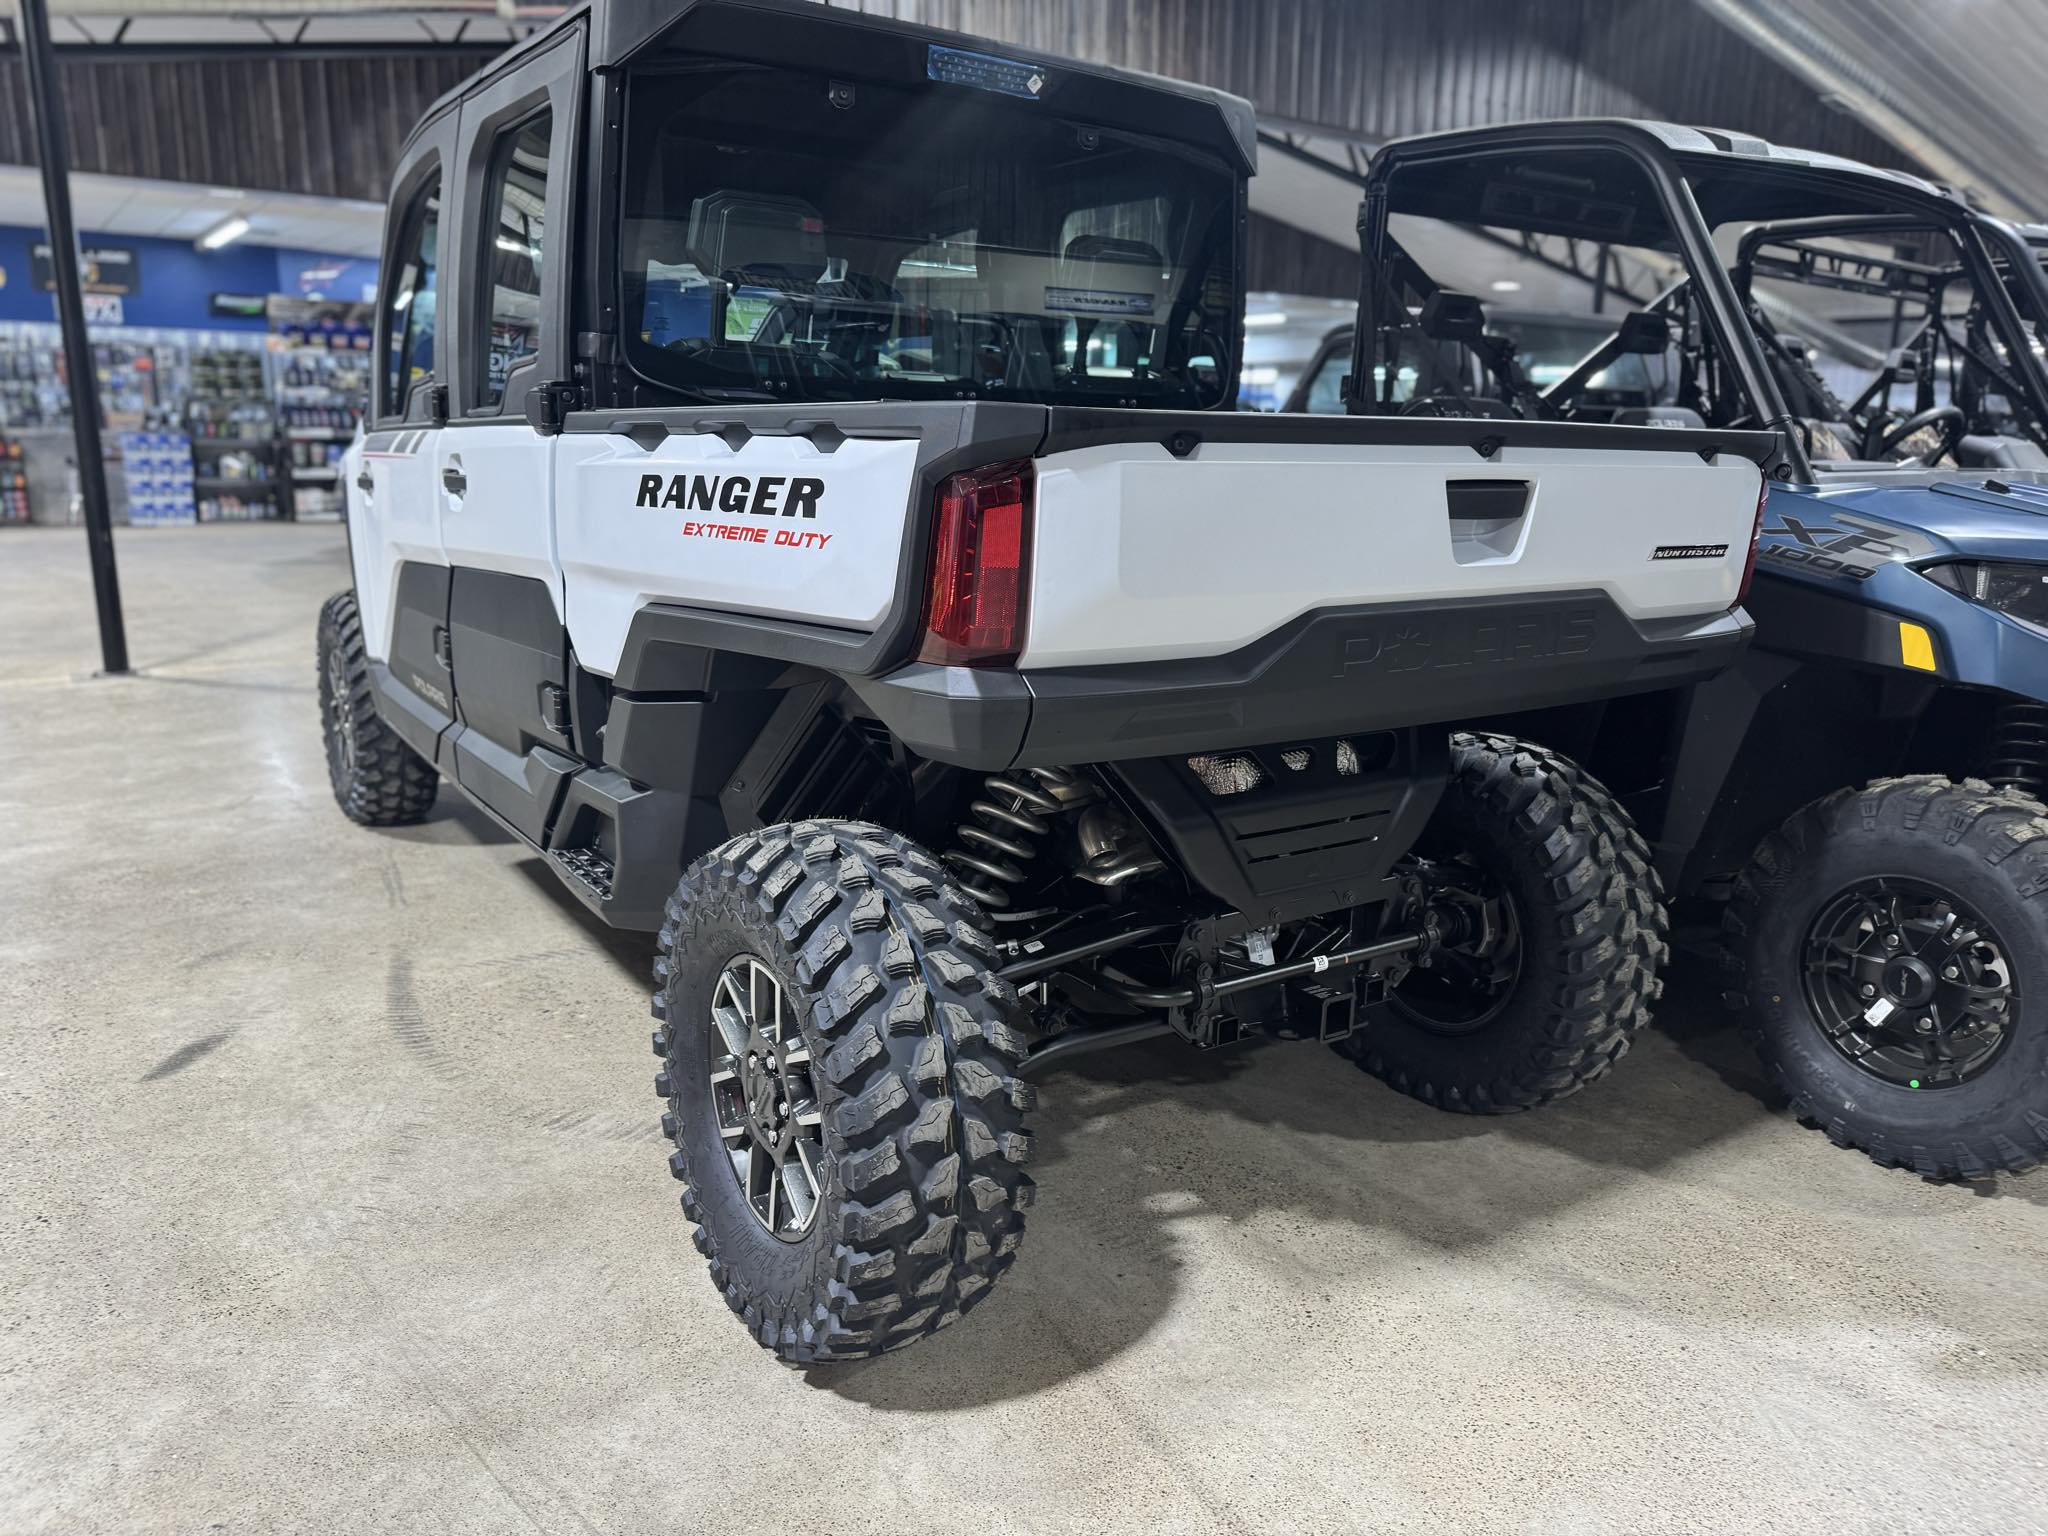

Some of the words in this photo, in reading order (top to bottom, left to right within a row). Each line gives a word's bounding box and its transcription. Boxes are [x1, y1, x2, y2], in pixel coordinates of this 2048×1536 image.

[635, 474, 825, 519] RANGER
[682, 522, 769, 544] EXTREME
[774, 530, 833, 550] DUTY
[1654, 545, 1729, 559] NORTHSTAR
[1761, 514, 1911, 556] XP
[1764, 543, 1880, 582] 1000
[1331, 608, 1600, 679] POLARIS
